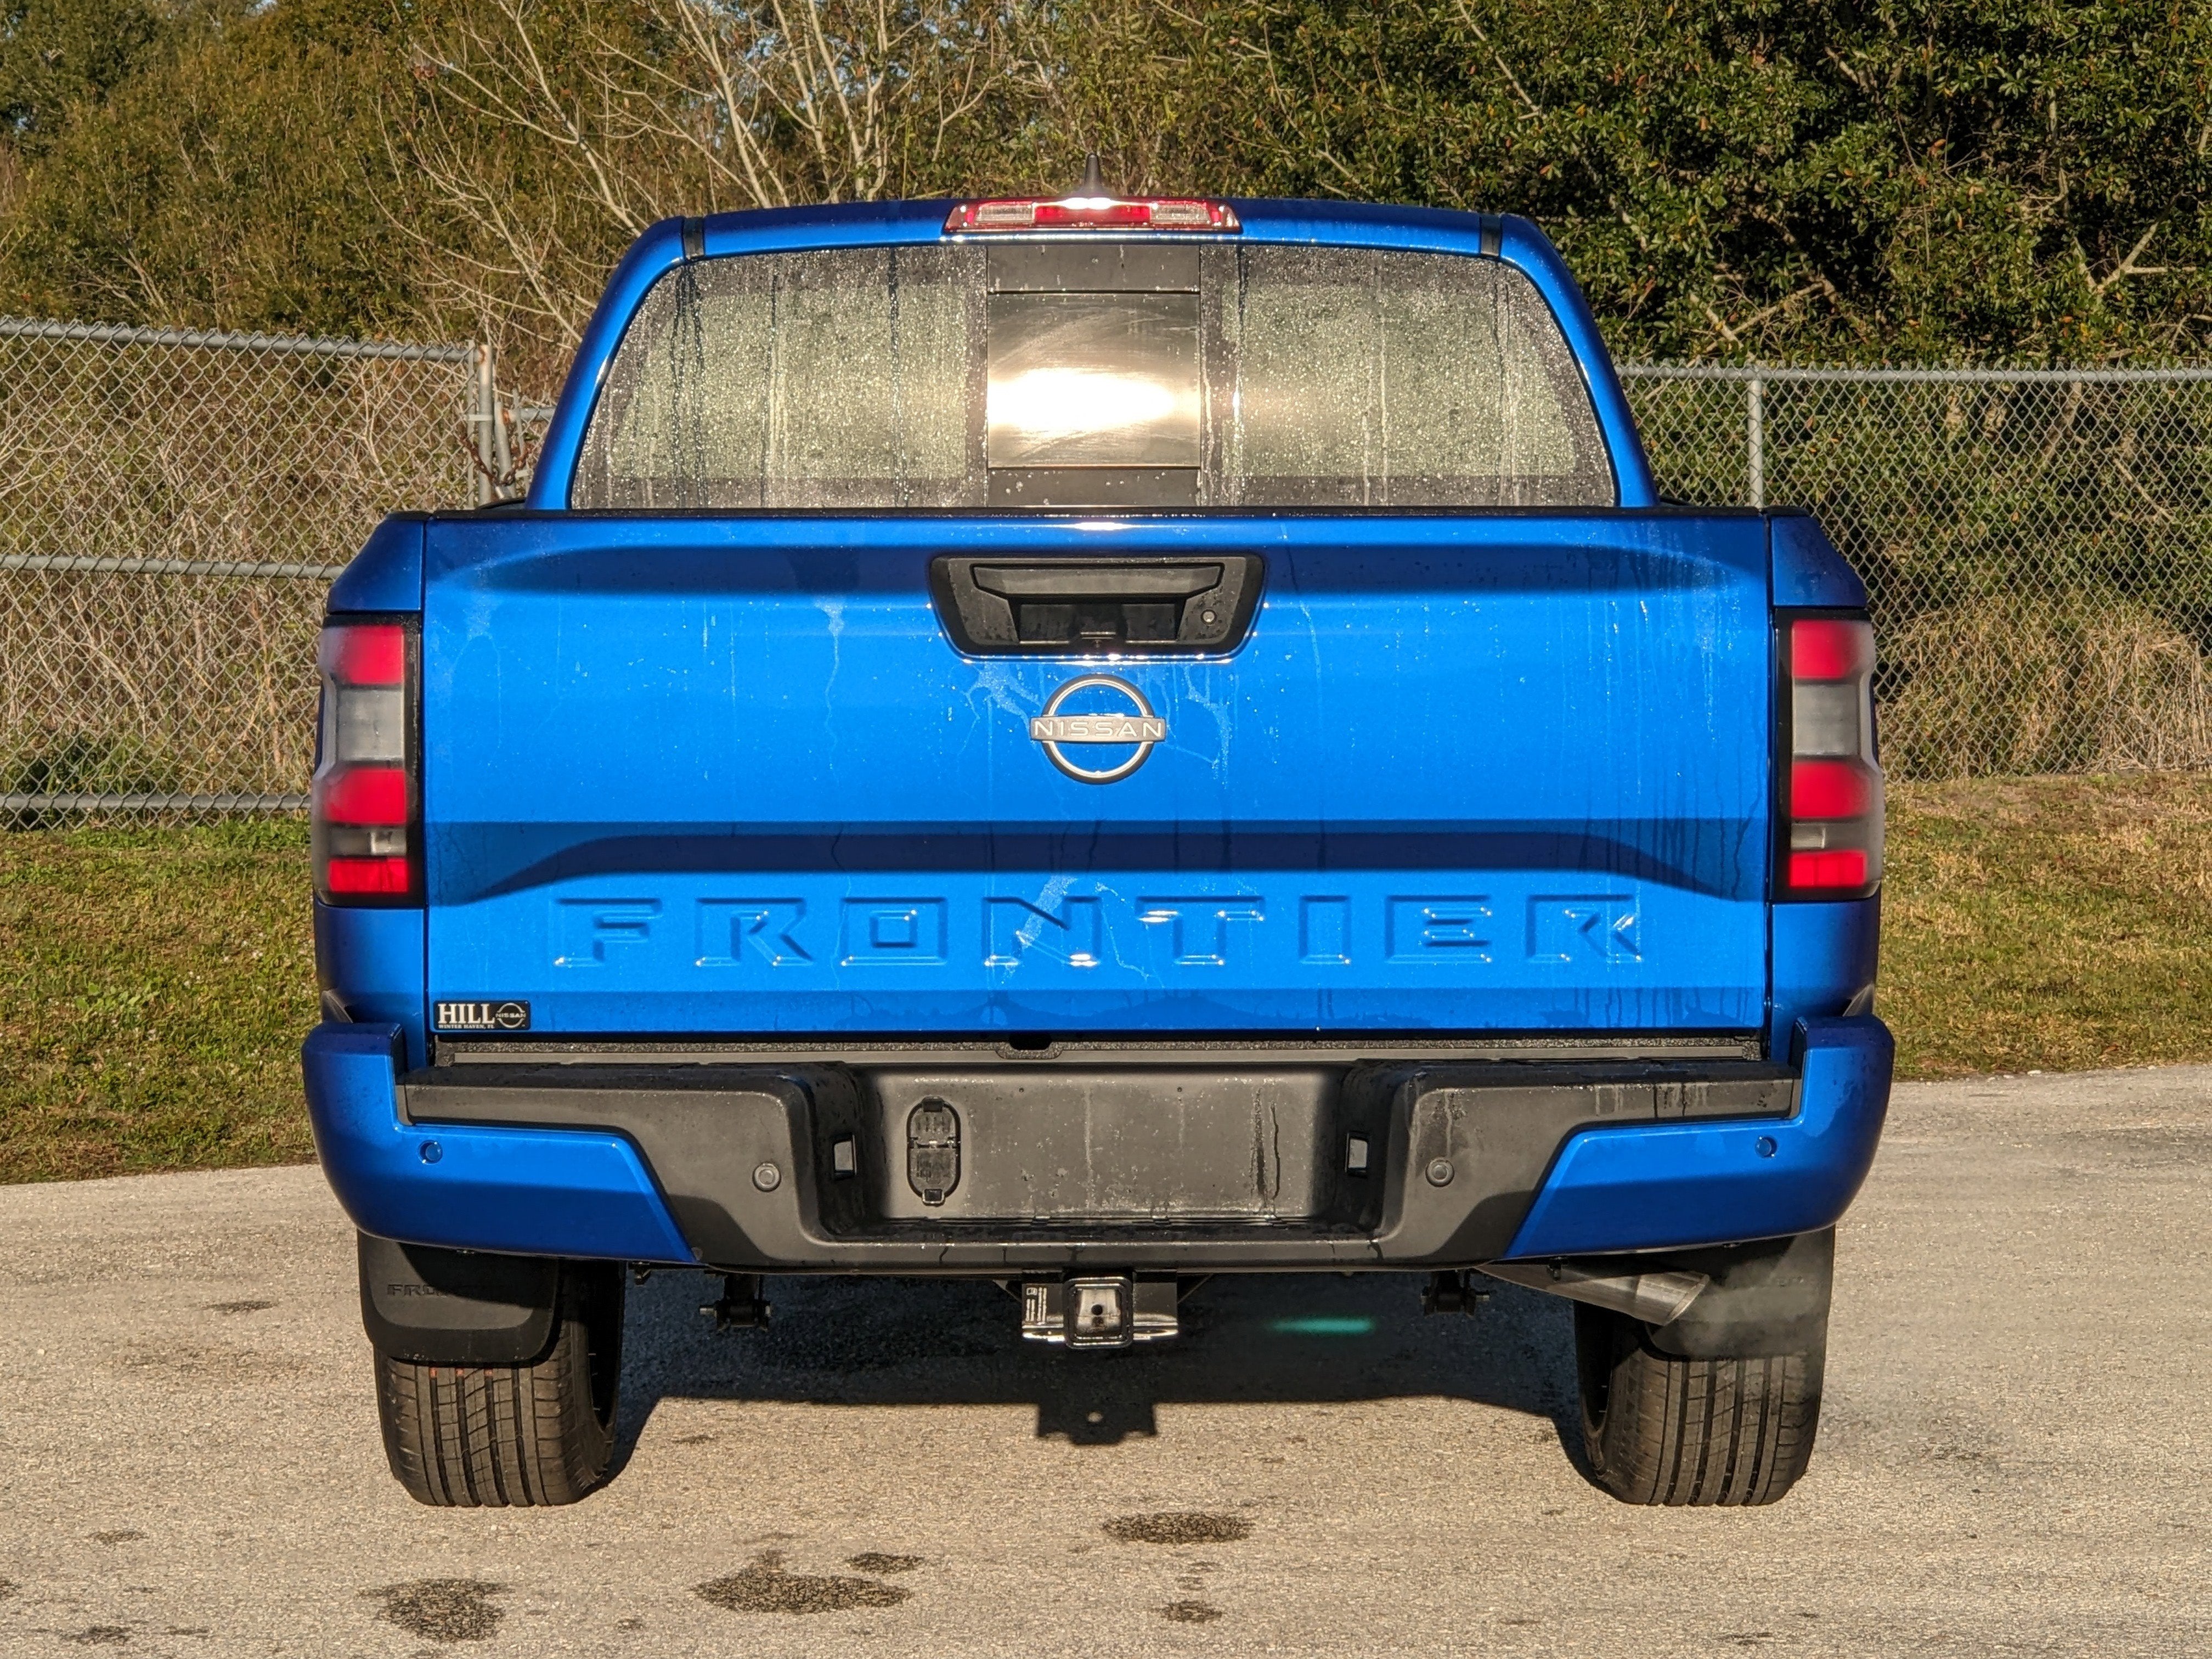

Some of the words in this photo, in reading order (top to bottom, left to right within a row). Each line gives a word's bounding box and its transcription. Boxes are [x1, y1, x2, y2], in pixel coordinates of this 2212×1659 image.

[1035, 721, 1161, 737] NISSAN
[551, 894, 1643, 968] FRONTIER
[438, 1003, 495, 1024] HILL
